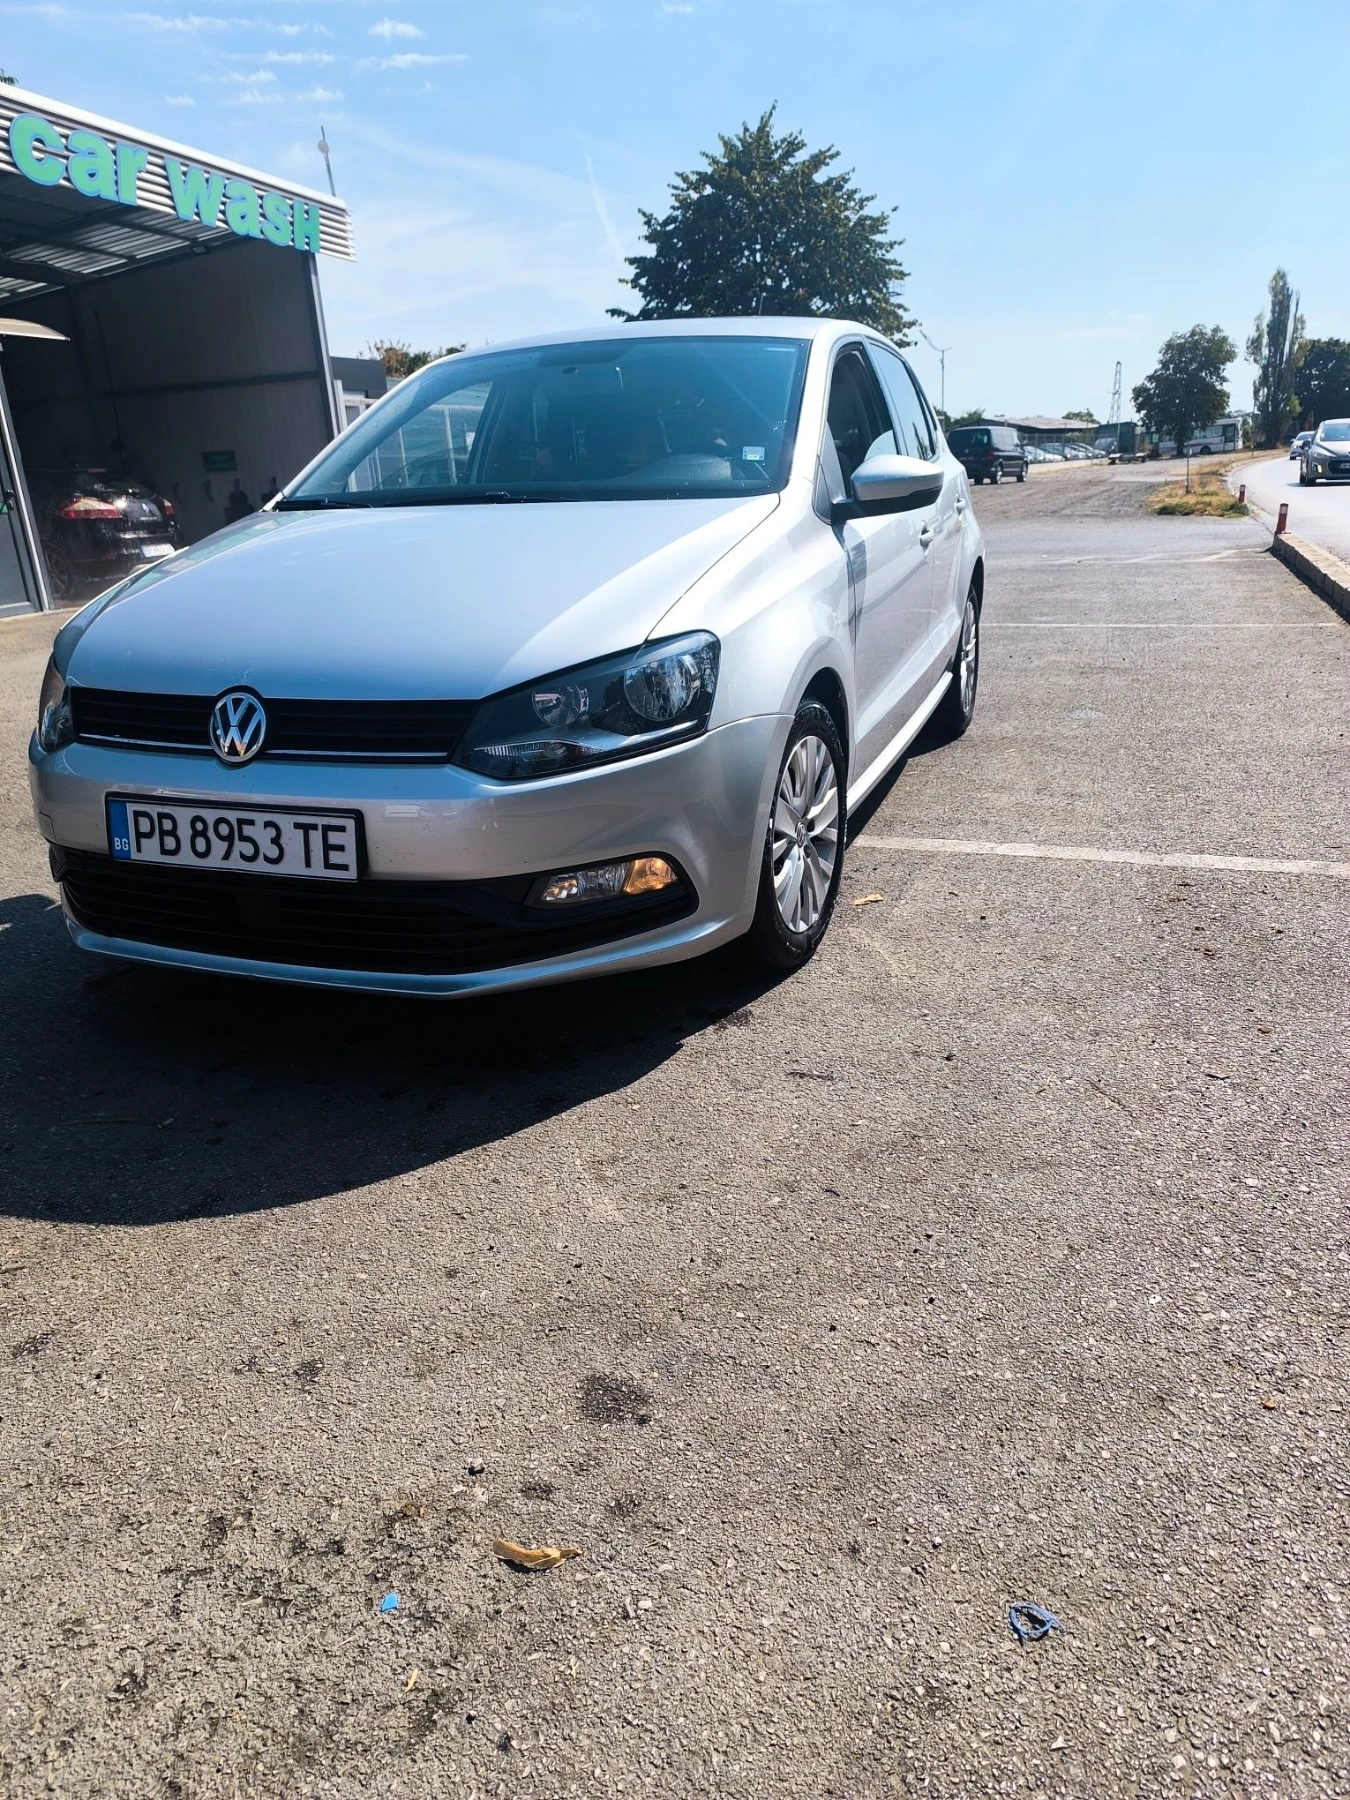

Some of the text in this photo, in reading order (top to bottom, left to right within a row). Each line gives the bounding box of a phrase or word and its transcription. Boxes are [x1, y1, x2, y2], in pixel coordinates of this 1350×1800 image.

[9, 113, 149, 206] car
[114, 837, 129, 851] BG
[132, 809, 349, 871] PB 8953 TE
